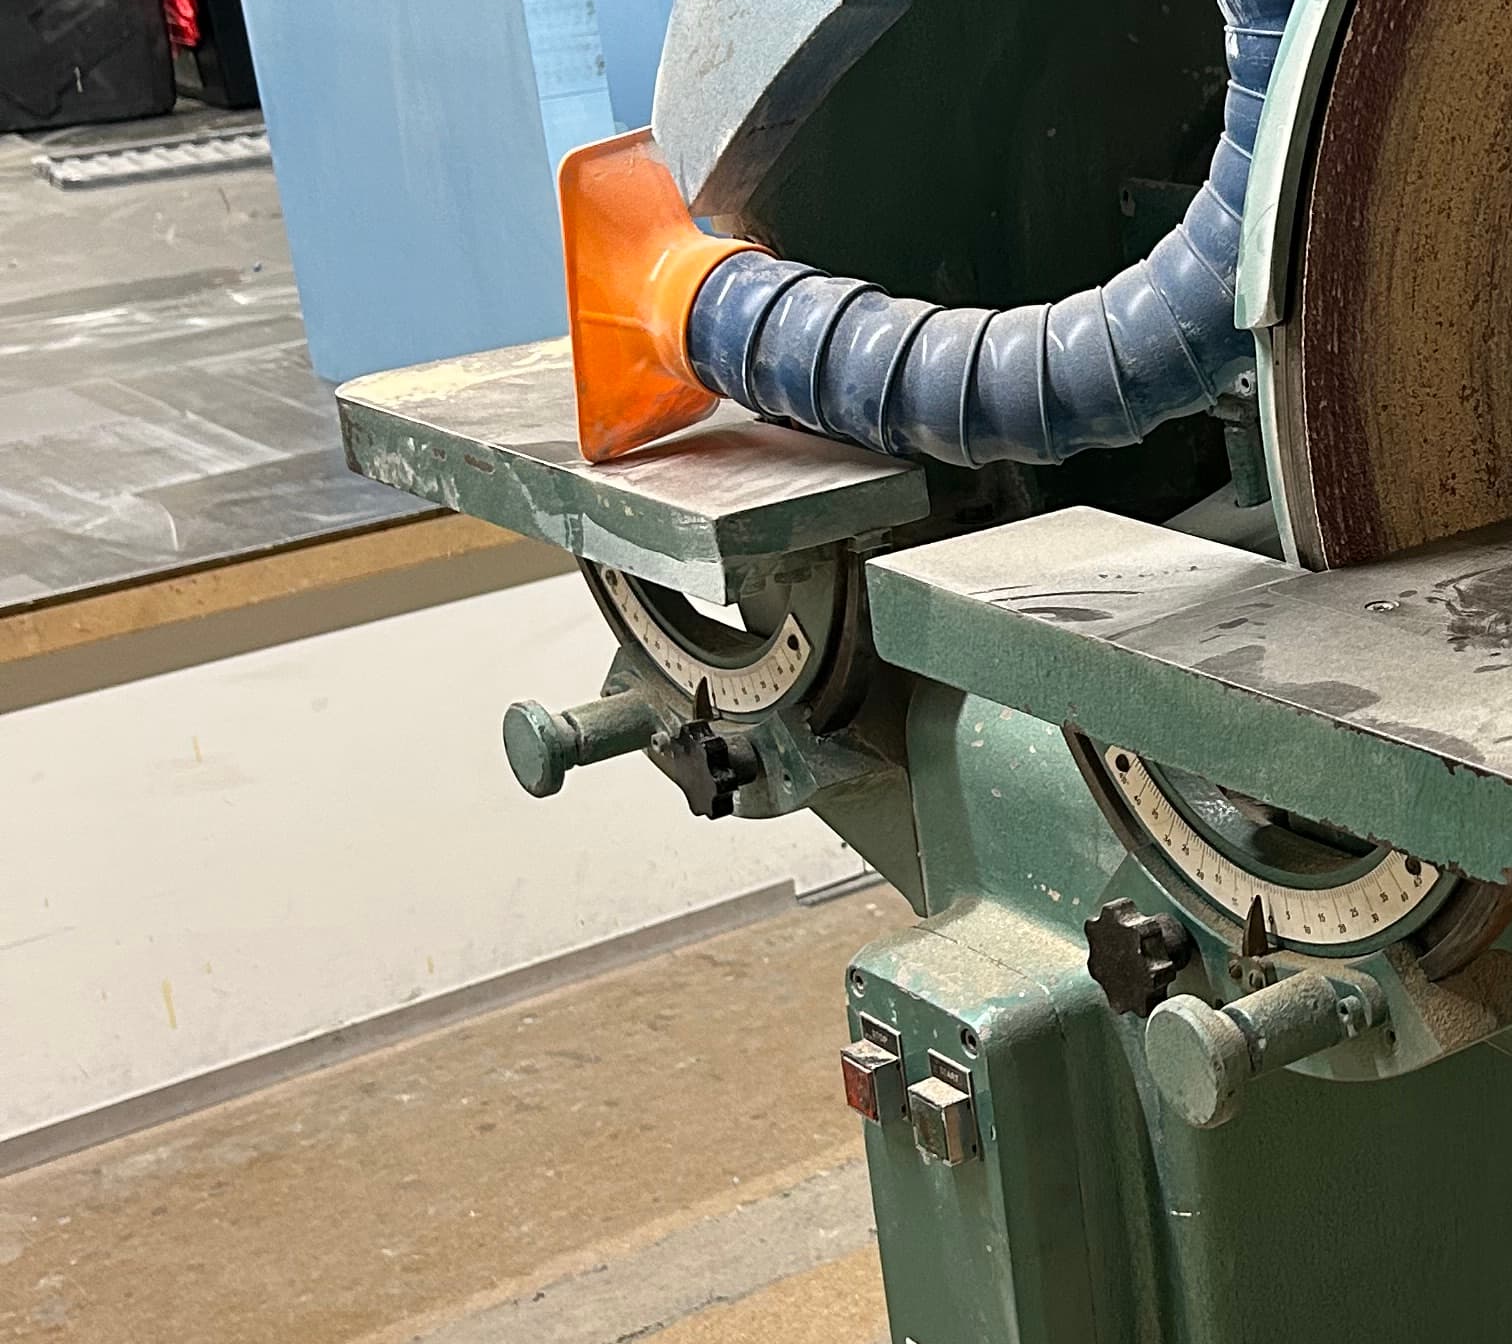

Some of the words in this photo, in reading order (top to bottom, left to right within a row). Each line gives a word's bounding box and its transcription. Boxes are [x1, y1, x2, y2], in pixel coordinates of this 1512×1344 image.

[1303, 924, 1311, 935] 10
[1318, 912, 1326, 922] 15
[1338, 923, 1347, 933] 20
[1350, 907, 1359, 918] 25
[1371, 913, 1379, 923] 30
[1380, 891, 1389, 903] 35
